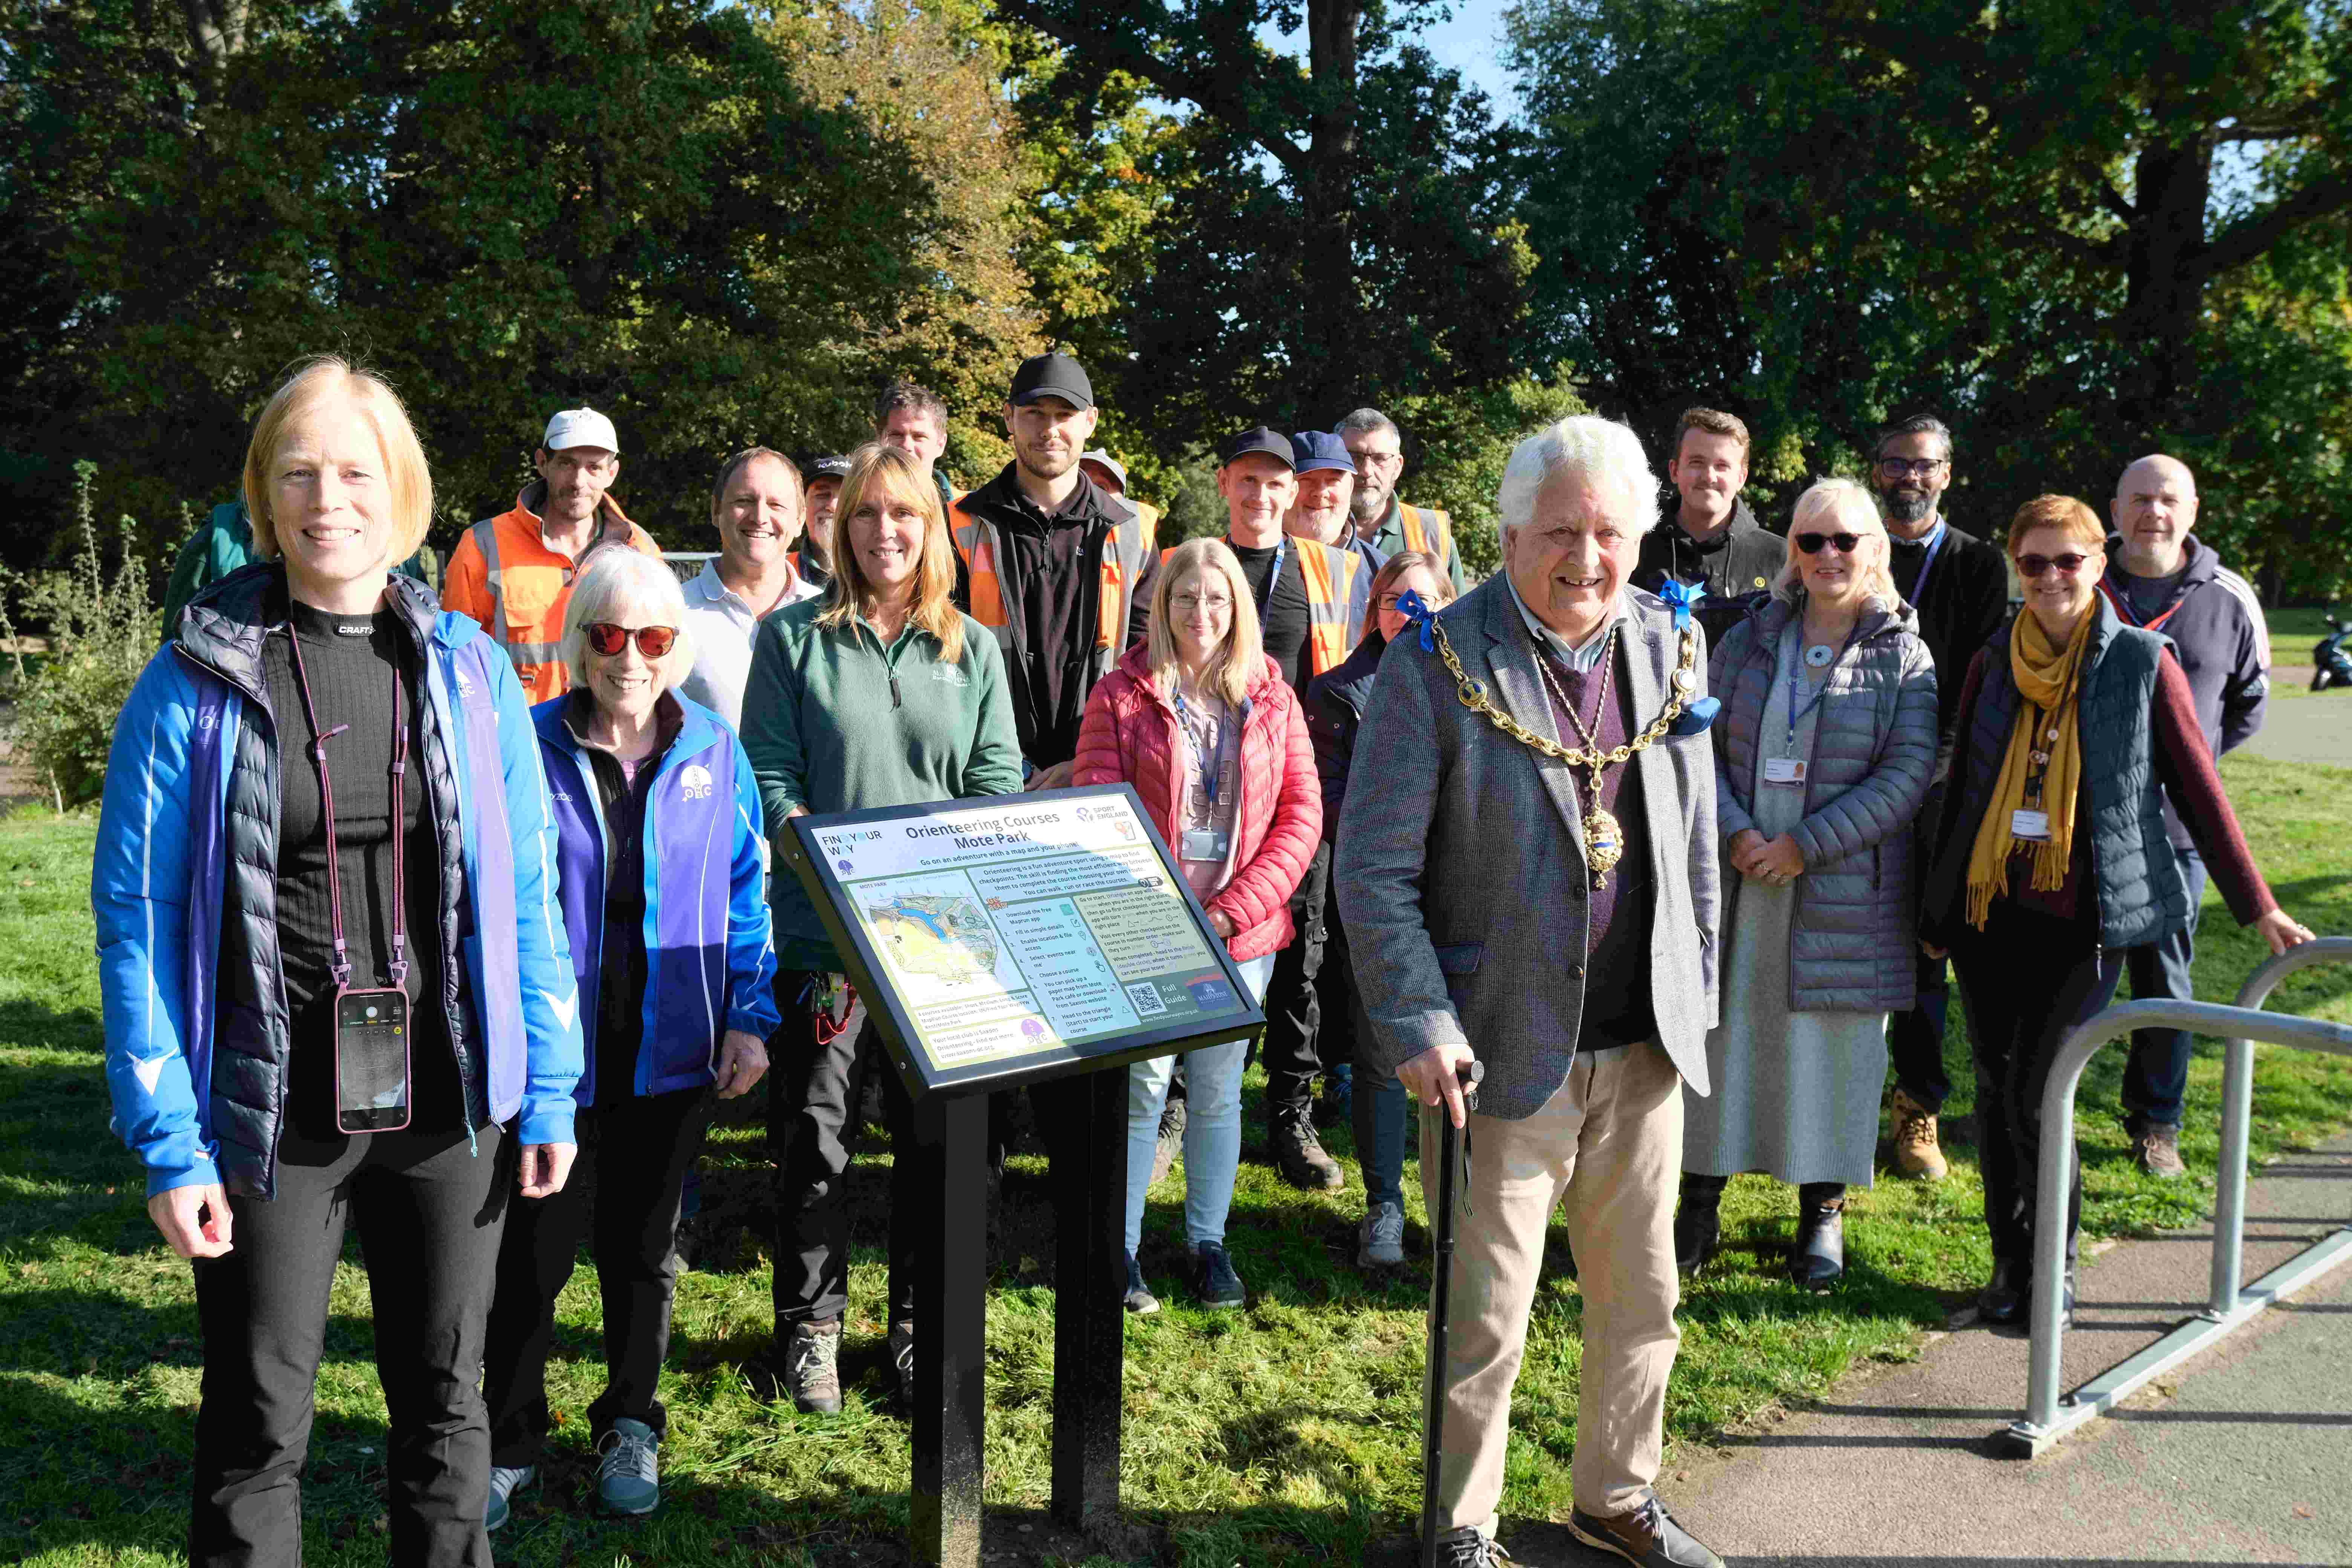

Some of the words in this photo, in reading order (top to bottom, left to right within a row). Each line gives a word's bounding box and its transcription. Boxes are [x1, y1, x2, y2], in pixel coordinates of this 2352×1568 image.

[1097, 811, 1128, 819] ENGLAND
[906, 820, 1002, 838] Orienteering
[1004, 814, 1060, 827] Courses
[954, 836, 994, 848] Mote
[995, 830, 1030, 844] Park
[953, 853, 987, 861] adventure
[1057, 841, 1079, 850] phone!
[983, 867, 1022, 875] Orienteering
[1162, 983, 1176, 992] Full
[1164, 995, 1187, 1003] Guide
